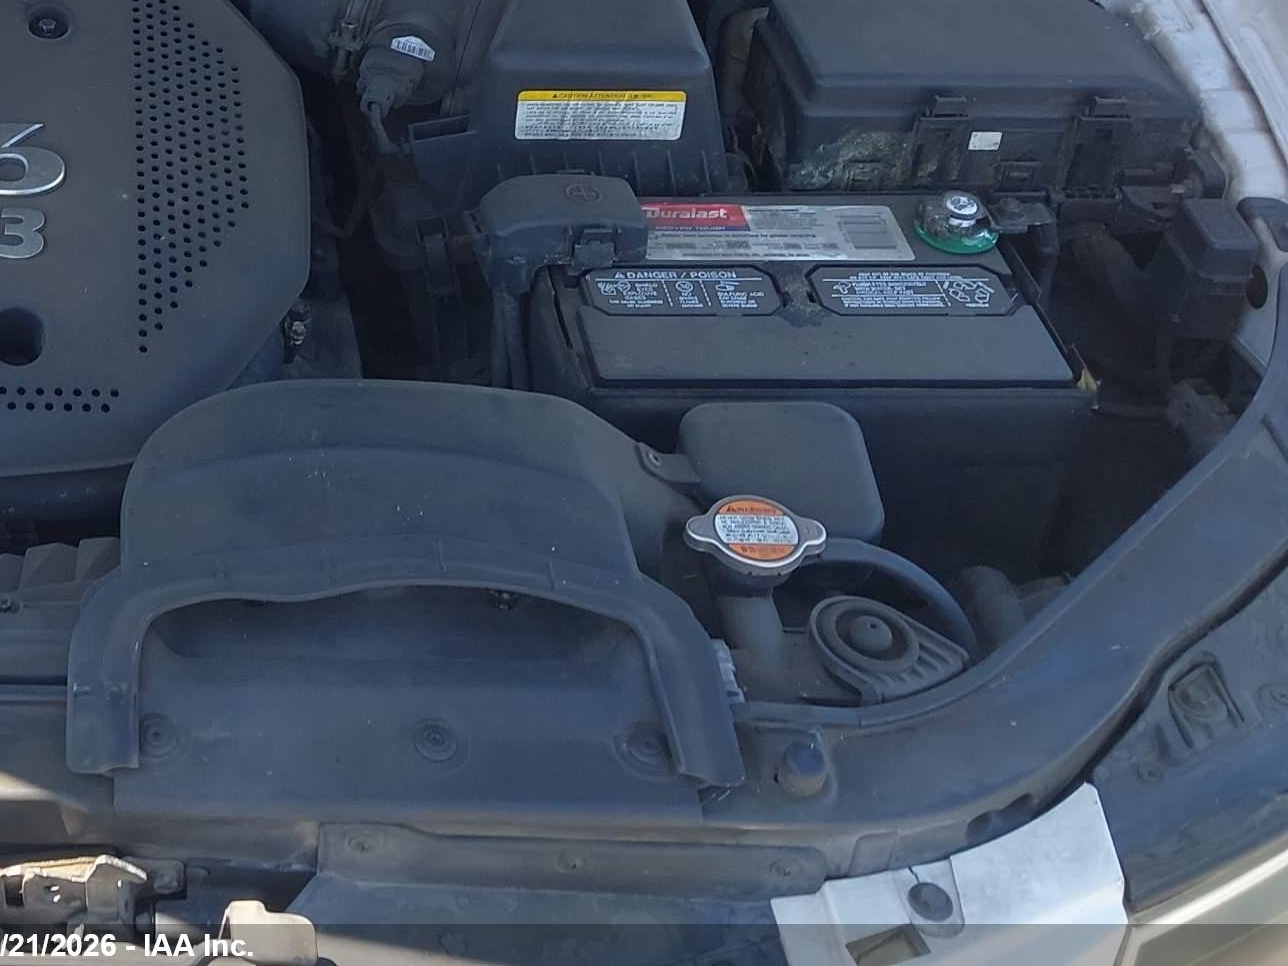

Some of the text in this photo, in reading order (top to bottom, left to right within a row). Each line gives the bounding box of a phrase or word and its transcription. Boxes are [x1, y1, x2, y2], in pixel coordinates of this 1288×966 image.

[641, 206, 728, 219] Duralast
[626, 271, 678, 279] DANGER
[691, 271, 737, 279] POISON
